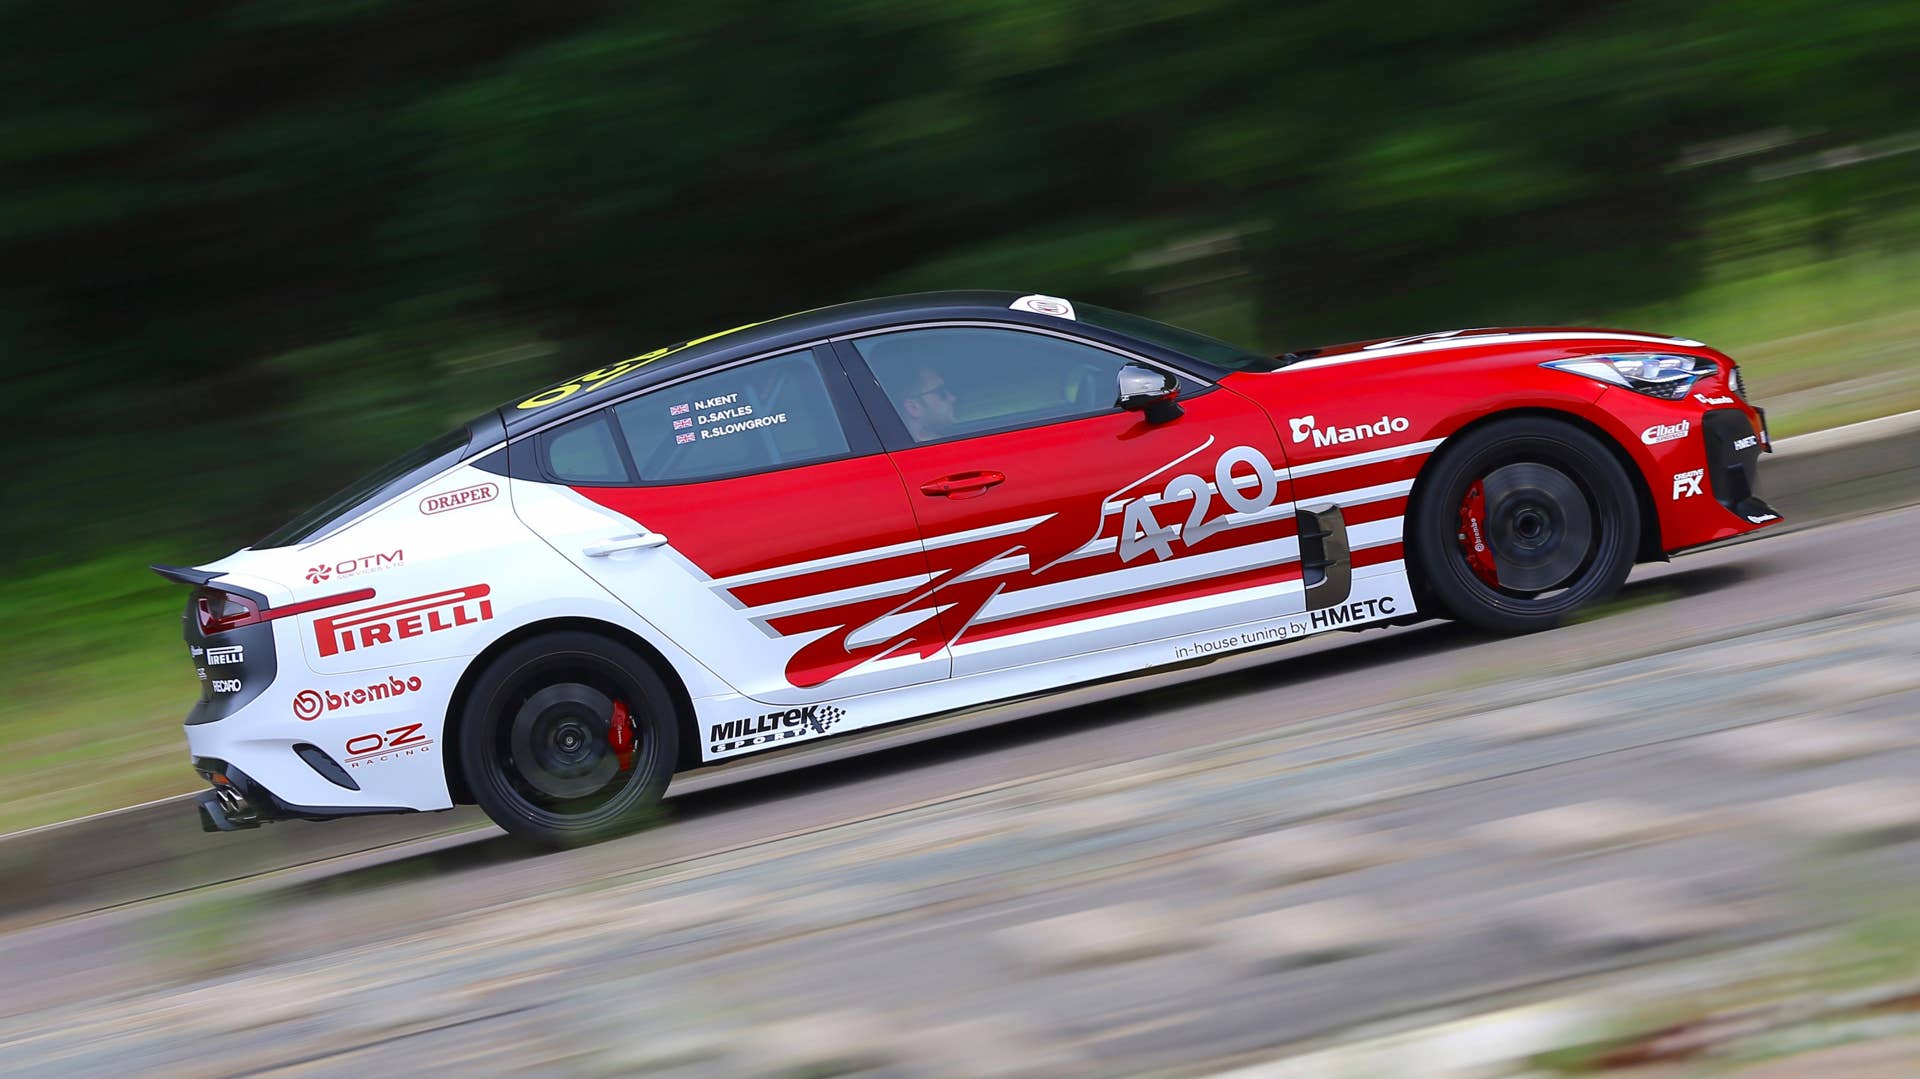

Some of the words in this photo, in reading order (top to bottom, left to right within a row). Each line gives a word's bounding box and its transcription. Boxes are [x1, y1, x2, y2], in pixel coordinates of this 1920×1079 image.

[694, 393, 738, 410] N.KENT
[697, 405, 753, 425] D.SAYLES
[700, 413, 787, 440] R.SLOWGROVE
[1311, 415, 1409, 447] Mando
[427, 487, 492, 512] DRAPER
[1672, 474, 1704, 500] FX
[1118, 445, 1278, 563] 420
[336, 549, 403, 574] OTM
[313, 583, 494, 658] PIRELLI
[1175, 636, 1239, 659] in-house
[1241, 625, 1288, 644] tuning
[1290, 620, 1308, 636] by
[1310, 596, 1397, 630] HMETC
[206, 645, 244, 666] PIRELLI
[327, 676, 422, 711] brembo
[352, 746, 430, 769] RACING
